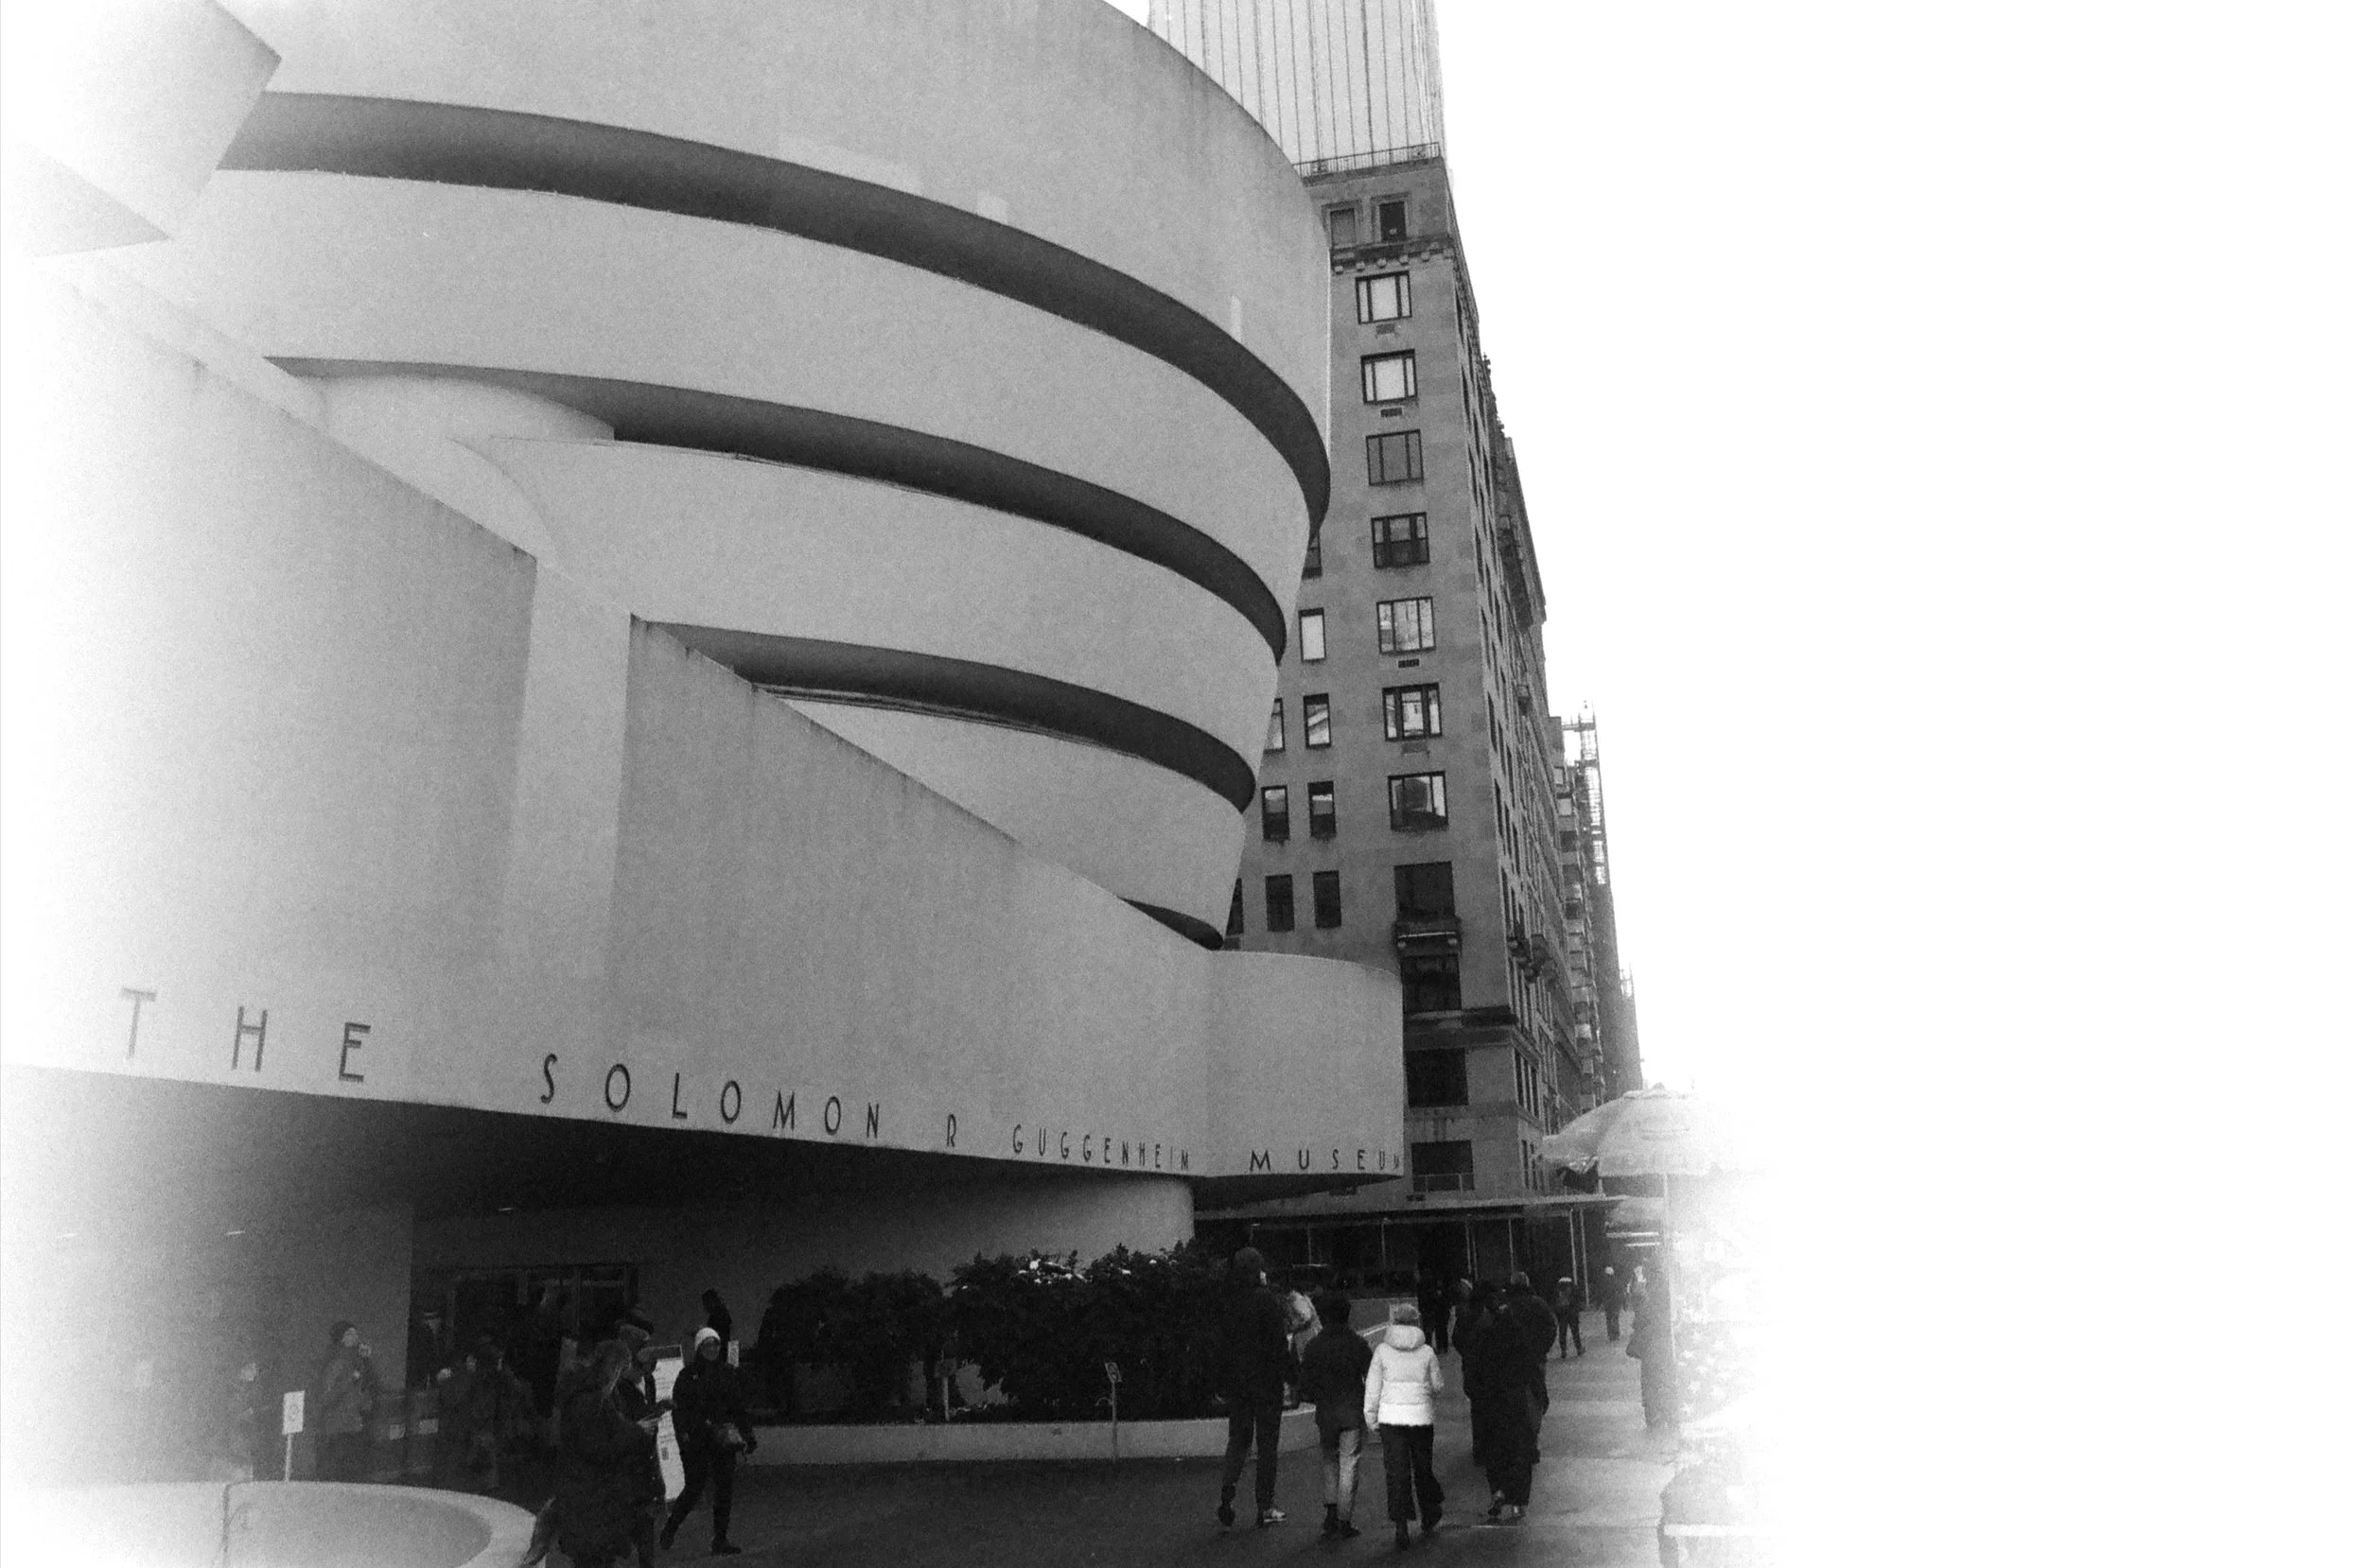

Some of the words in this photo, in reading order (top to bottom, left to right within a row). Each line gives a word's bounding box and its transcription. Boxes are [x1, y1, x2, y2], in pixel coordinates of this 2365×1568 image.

[120, 986, 372, 1083] THE
[540, 1053, 880, 1140] SOLOMON
[947, 1113, 957, 1147] R
[1012, 1124, 1189, 1171] GUGGENHEIM
